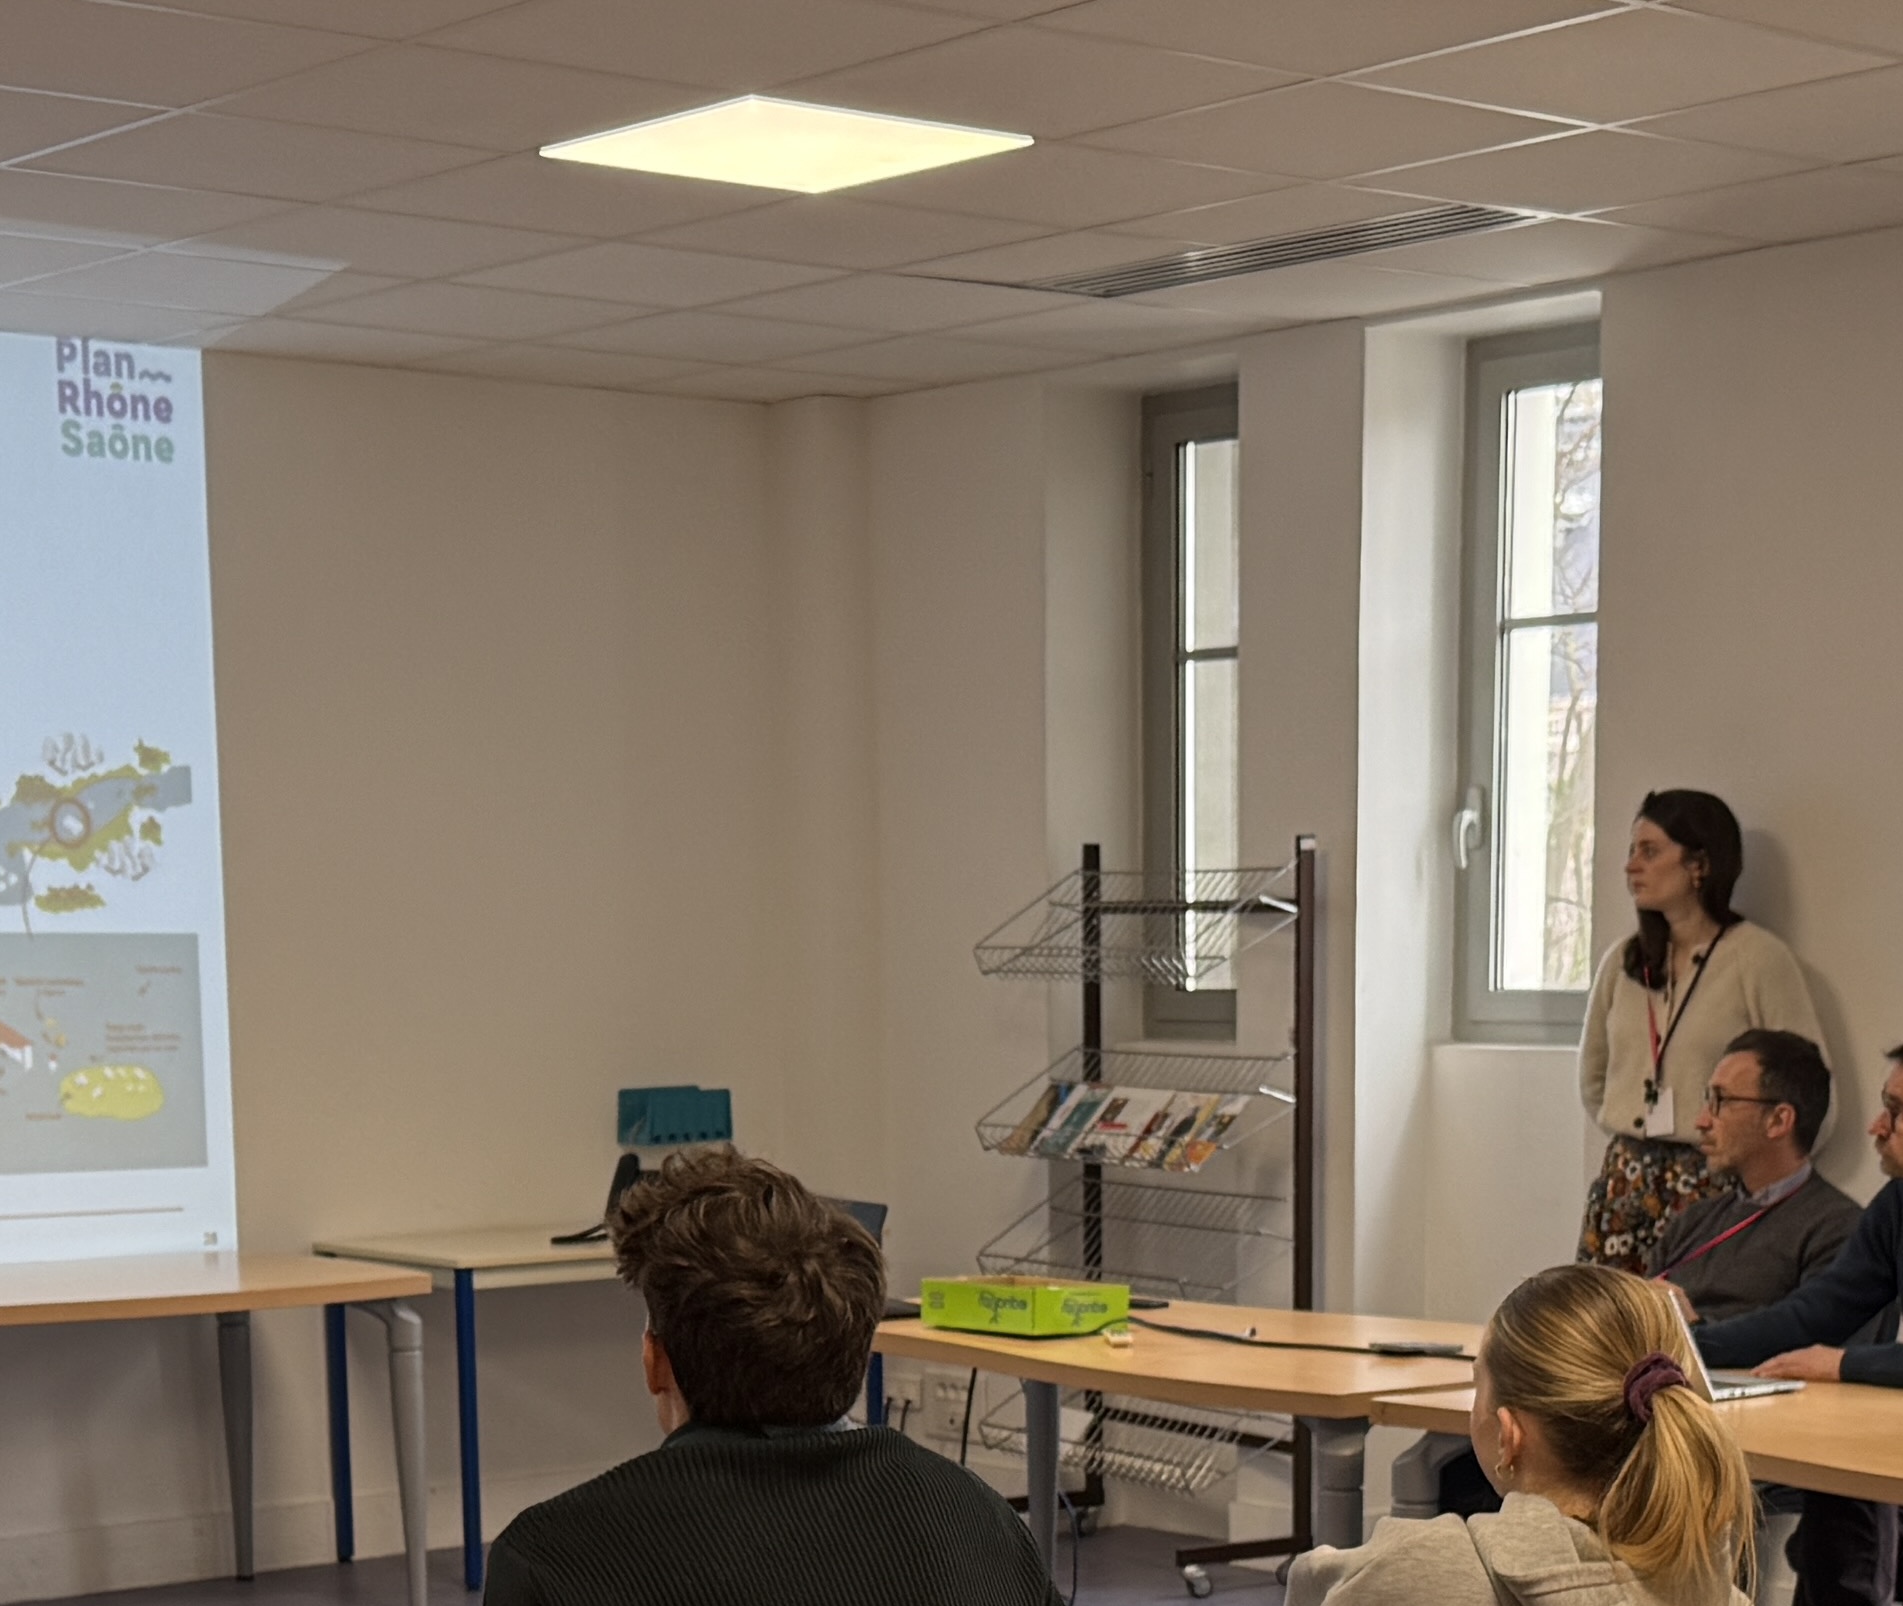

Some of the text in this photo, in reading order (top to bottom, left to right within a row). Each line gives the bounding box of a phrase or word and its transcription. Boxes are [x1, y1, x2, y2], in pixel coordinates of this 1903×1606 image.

[56, 336, 135, 380] Plan
[57, 377, 173, 424] Rhône
[62, 420, 174, 463] Saône
